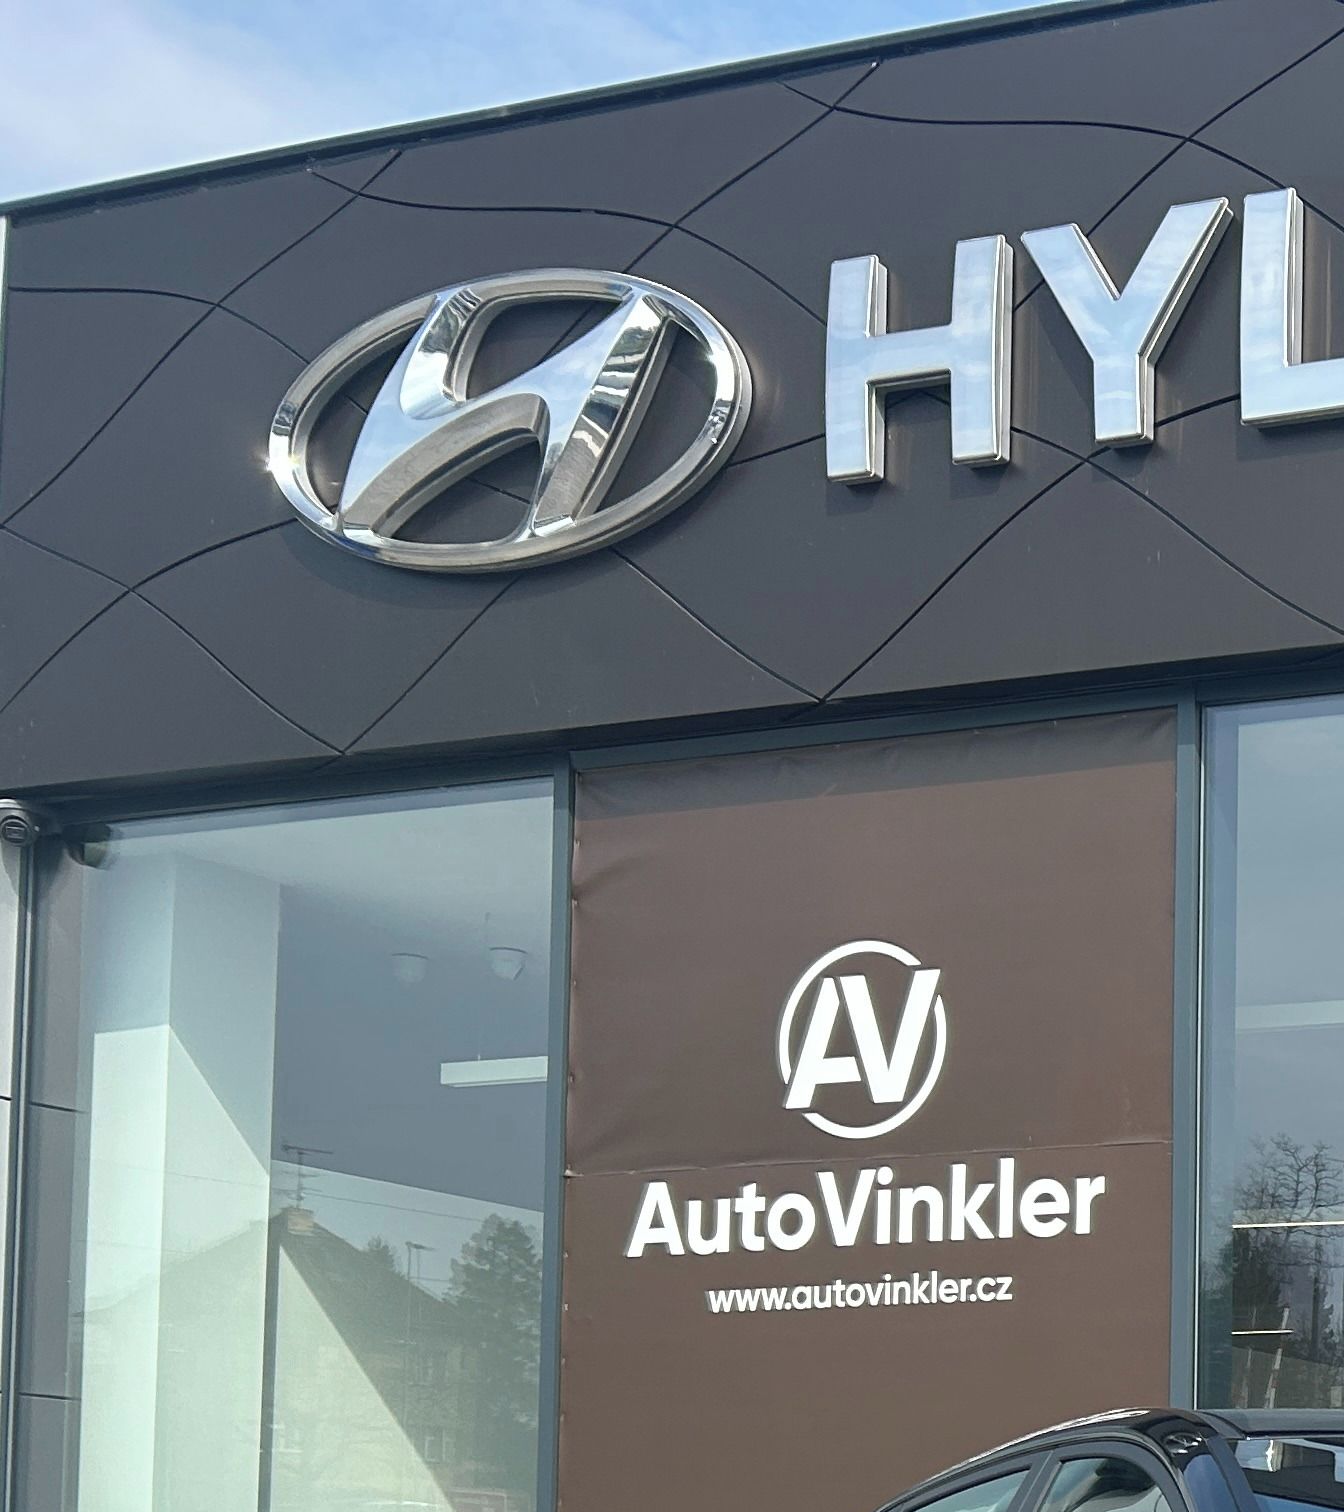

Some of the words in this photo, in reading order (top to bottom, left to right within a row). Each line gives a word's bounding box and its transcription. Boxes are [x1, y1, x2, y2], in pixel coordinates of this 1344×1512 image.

[783, 968, 941, 1110] AV
[625, 1158, 1105, 1258] AutoVinkler
[707, 1271, 1013, 1314] www.autovinkler.cz
